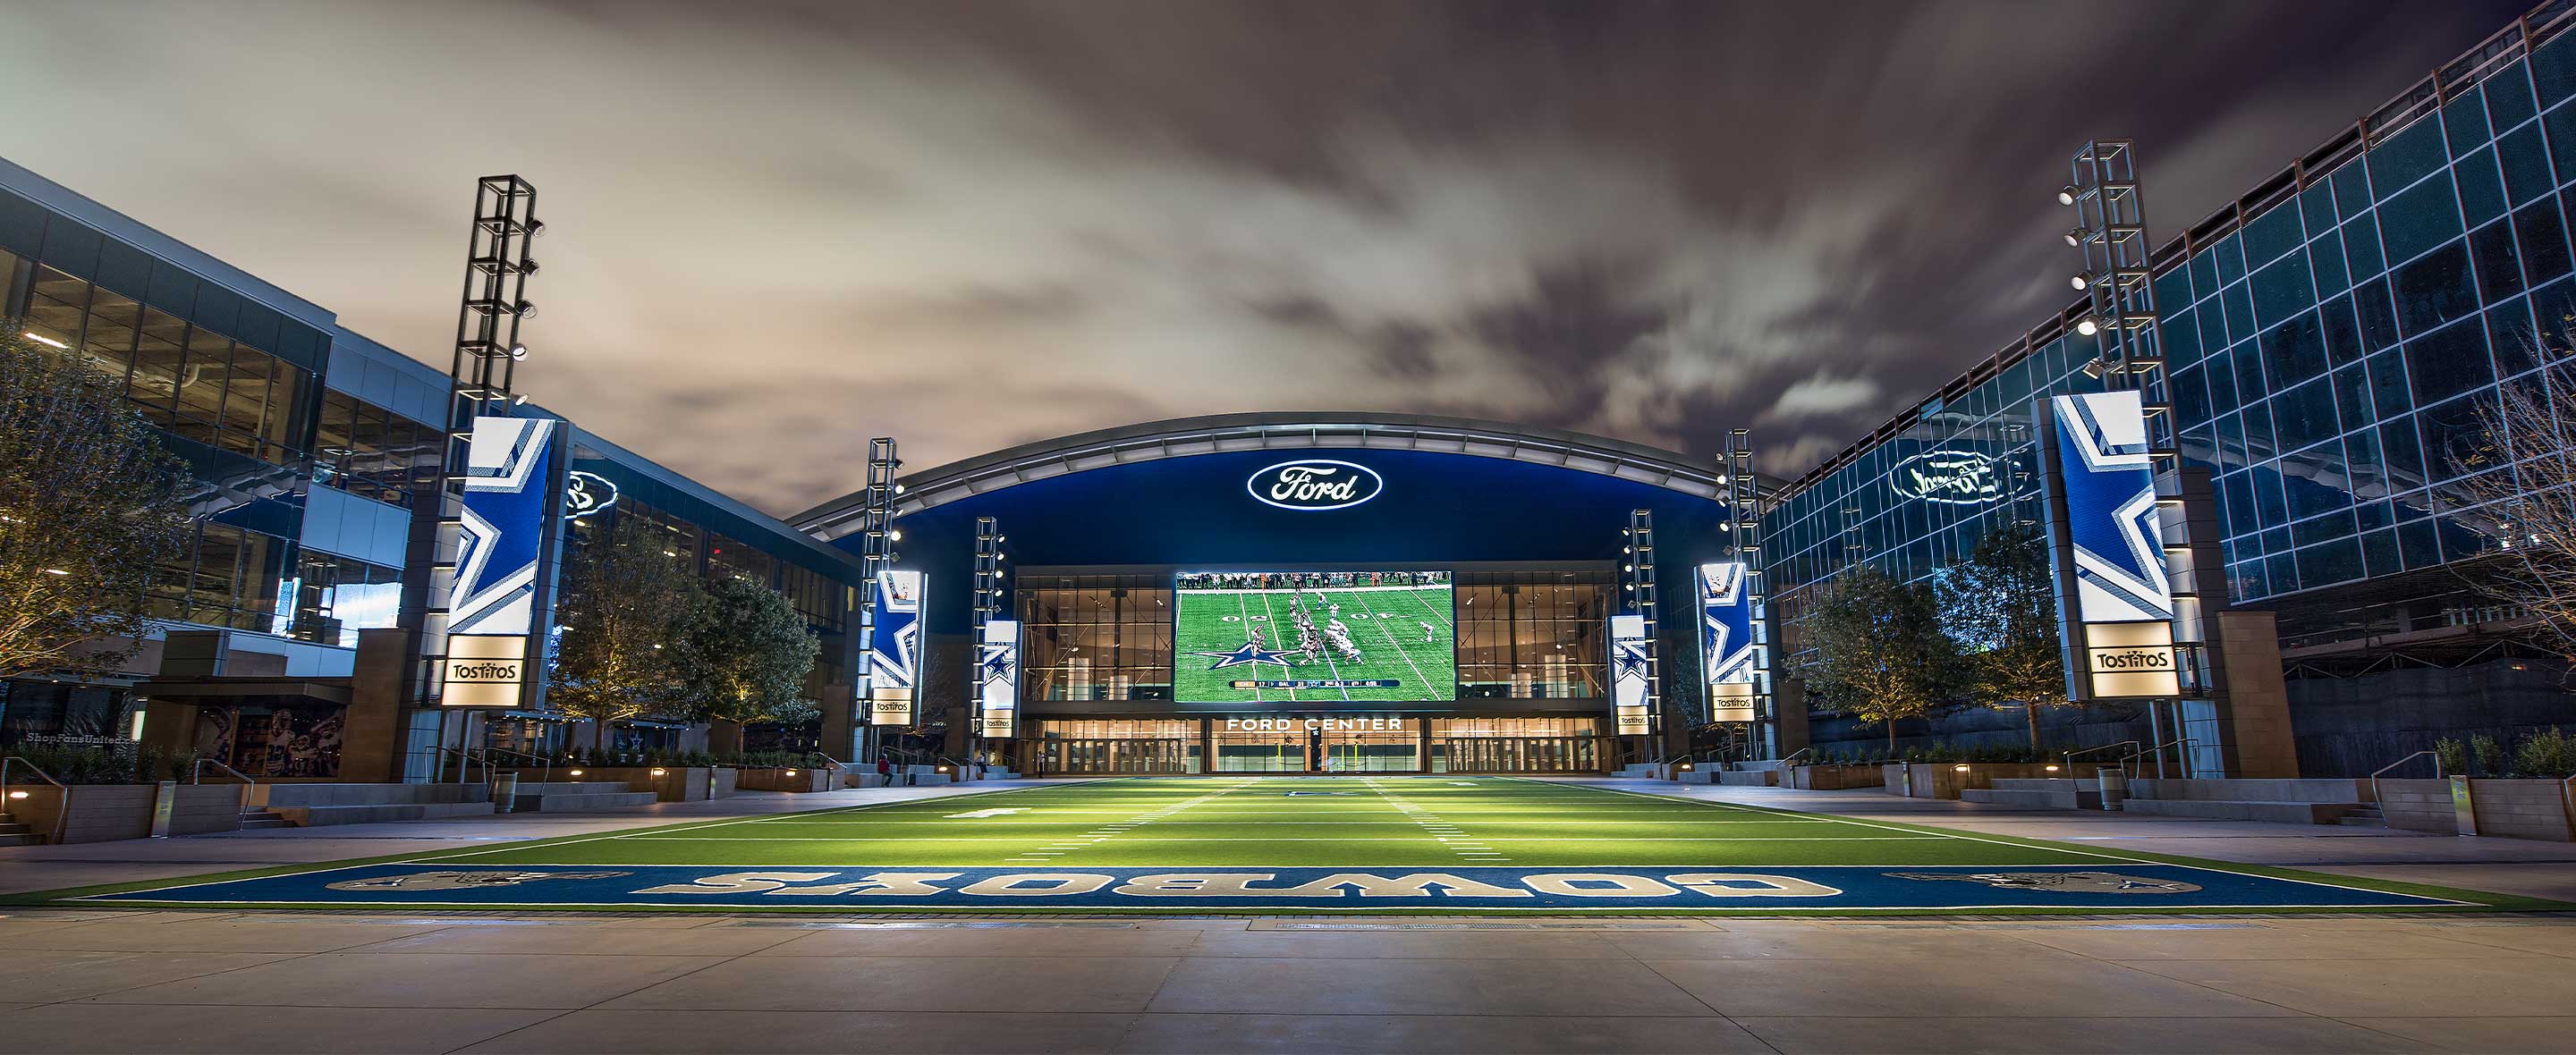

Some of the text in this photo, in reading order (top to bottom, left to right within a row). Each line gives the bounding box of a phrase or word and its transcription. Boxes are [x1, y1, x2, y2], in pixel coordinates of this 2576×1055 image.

[1271, 466, 1359, 501] Ford
[1227, 718, 1402, 730] FORD CENTER
[628, 872, 1843, 897] COWBOYS
